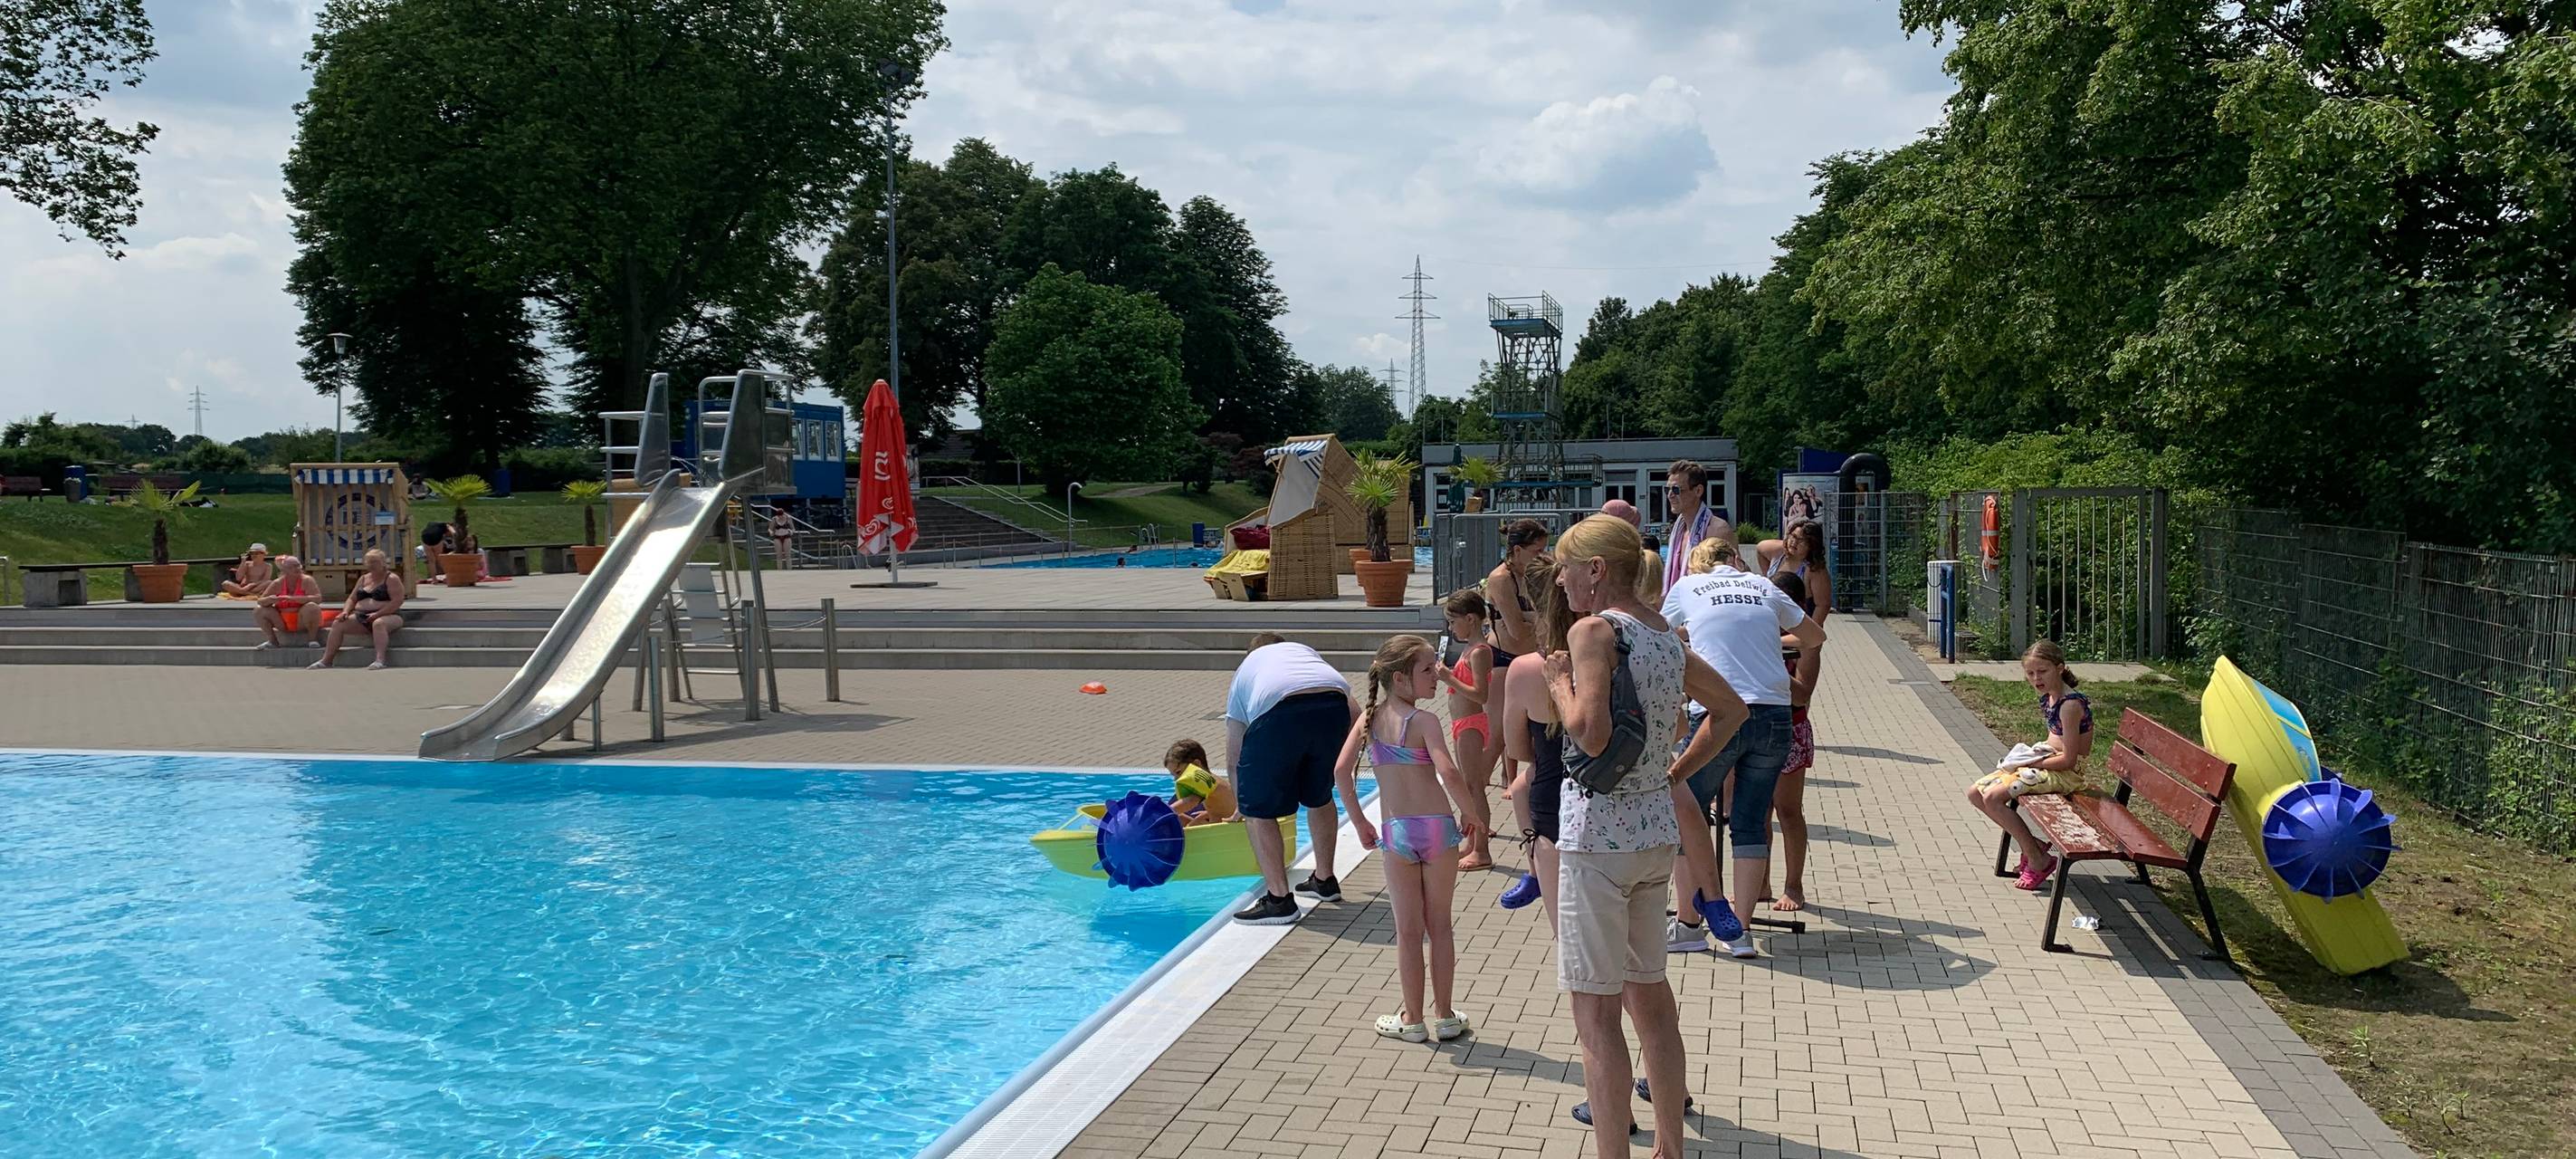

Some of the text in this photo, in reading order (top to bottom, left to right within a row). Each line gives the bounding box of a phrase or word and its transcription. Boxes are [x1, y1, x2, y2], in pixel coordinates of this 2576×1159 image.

[1693, 580, 1768, 597] Freibad Dellwig
[1711, 594, 1762, 606] HESSE
